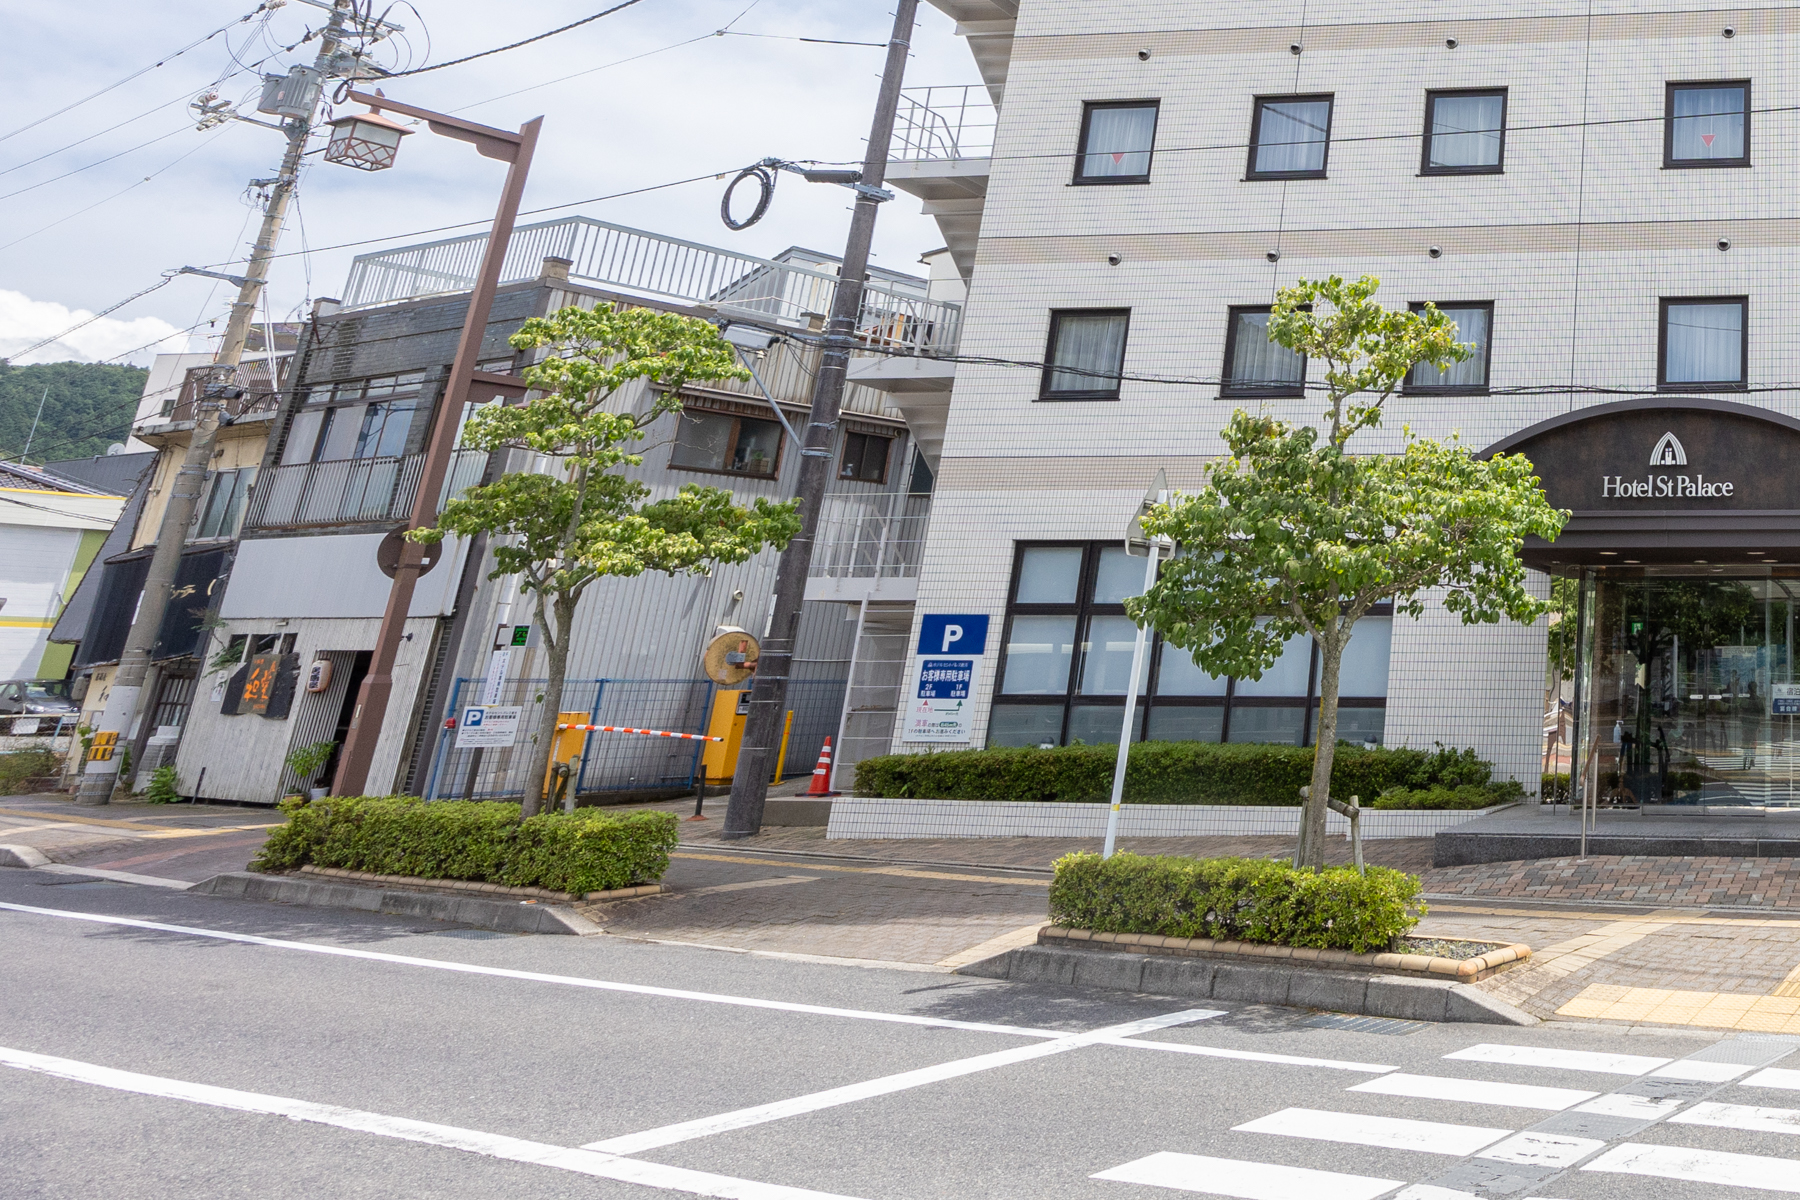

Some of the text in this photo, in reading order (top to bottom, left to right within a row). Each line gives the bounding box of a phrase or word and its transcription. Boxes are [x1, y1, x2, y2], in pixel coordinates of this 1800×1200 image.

[1602, 474, 1734, 498] Hotel St Palace
[512, 626, 528, 646] 空
[941, 624, 963, 652] P
[921, 670, 971, 682] お客様専用駐車場
[466, 711, 481, 725] P
